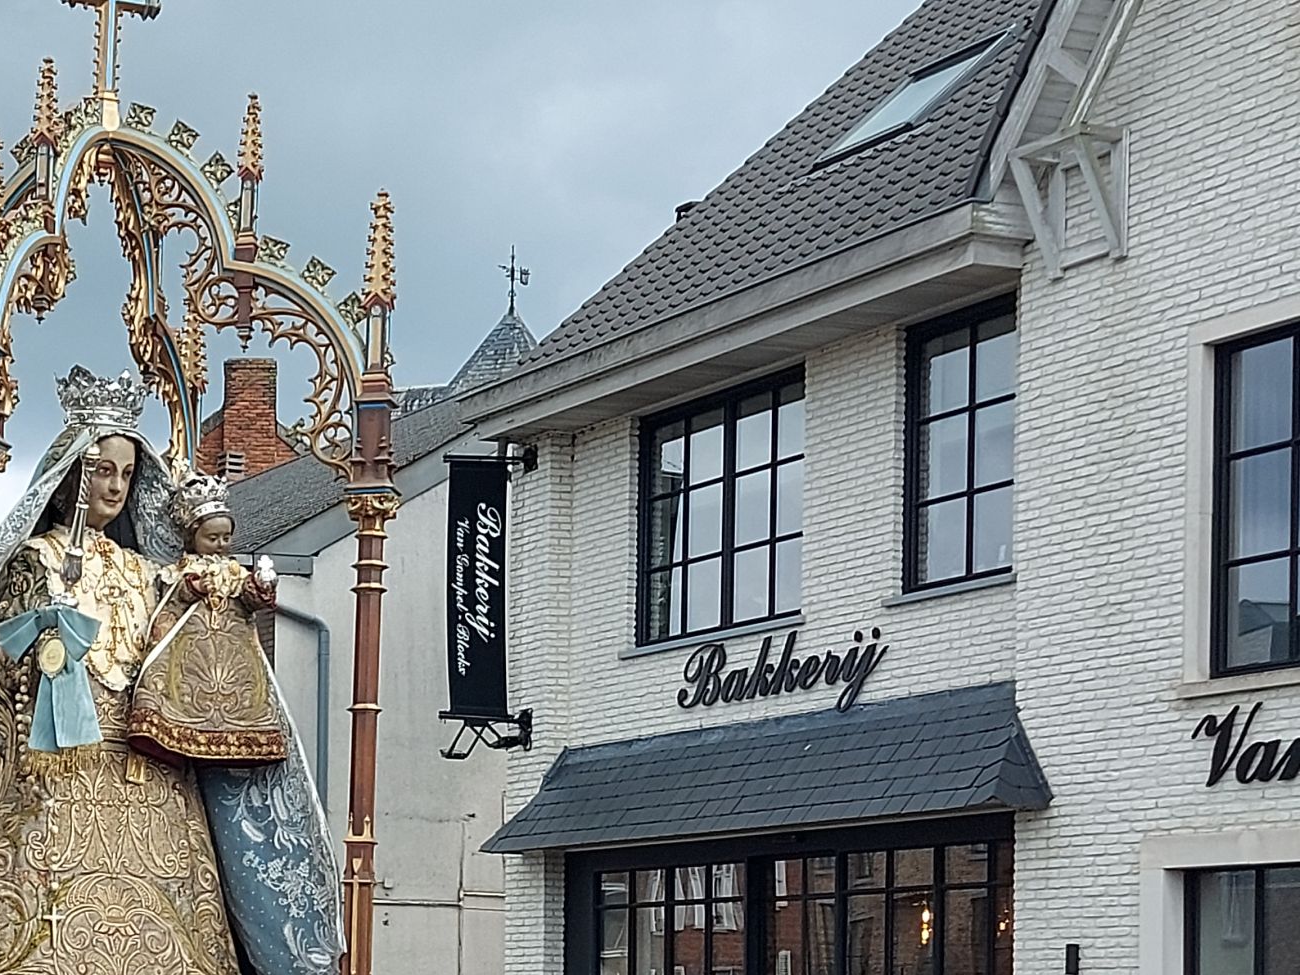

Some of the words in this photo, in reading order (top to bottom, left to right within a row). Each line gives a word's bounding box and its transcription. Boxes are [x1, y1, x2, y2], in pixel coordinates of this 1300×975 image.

[456, 517, 471, 552] Van
[466, 502, 502, 643] Bakkerij
[677, 627, 890, 713] Bakkerij
